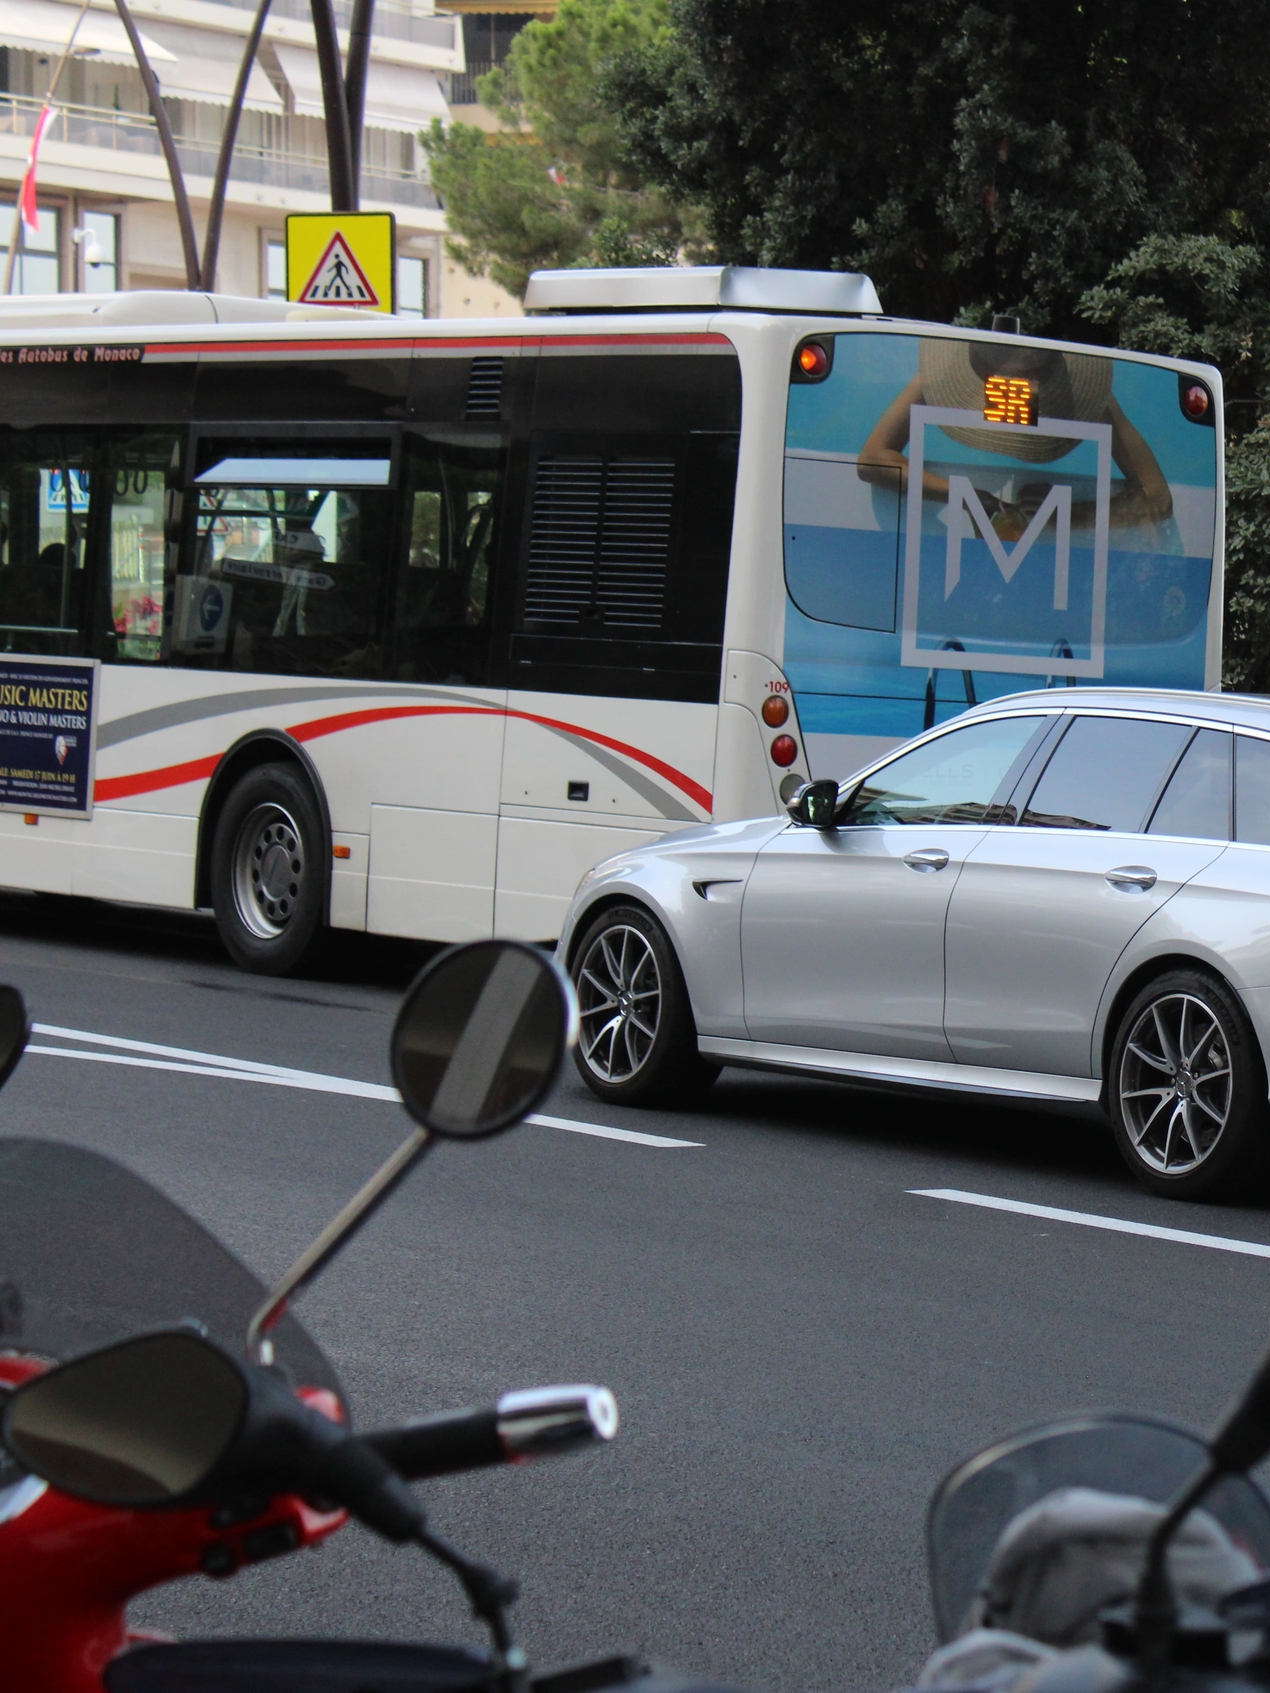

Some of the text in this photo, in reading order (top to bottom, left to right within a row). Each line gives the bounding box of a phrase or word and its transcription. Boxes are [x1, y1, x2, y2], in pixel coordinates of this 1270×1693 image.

[0, 346, 140, 364] es Autobus de Monaco
[945, 475, 1072, 611] M
[769, 681, 789, 694] 109
[28, 687, 88, 711] MASTERS
[10, 710, 17, 724] &
[18, 711, 48, 726] VIOLIN
[49, 714, 87, 730] MASTERS
[10, 769, 33, 780] SAMEDI
